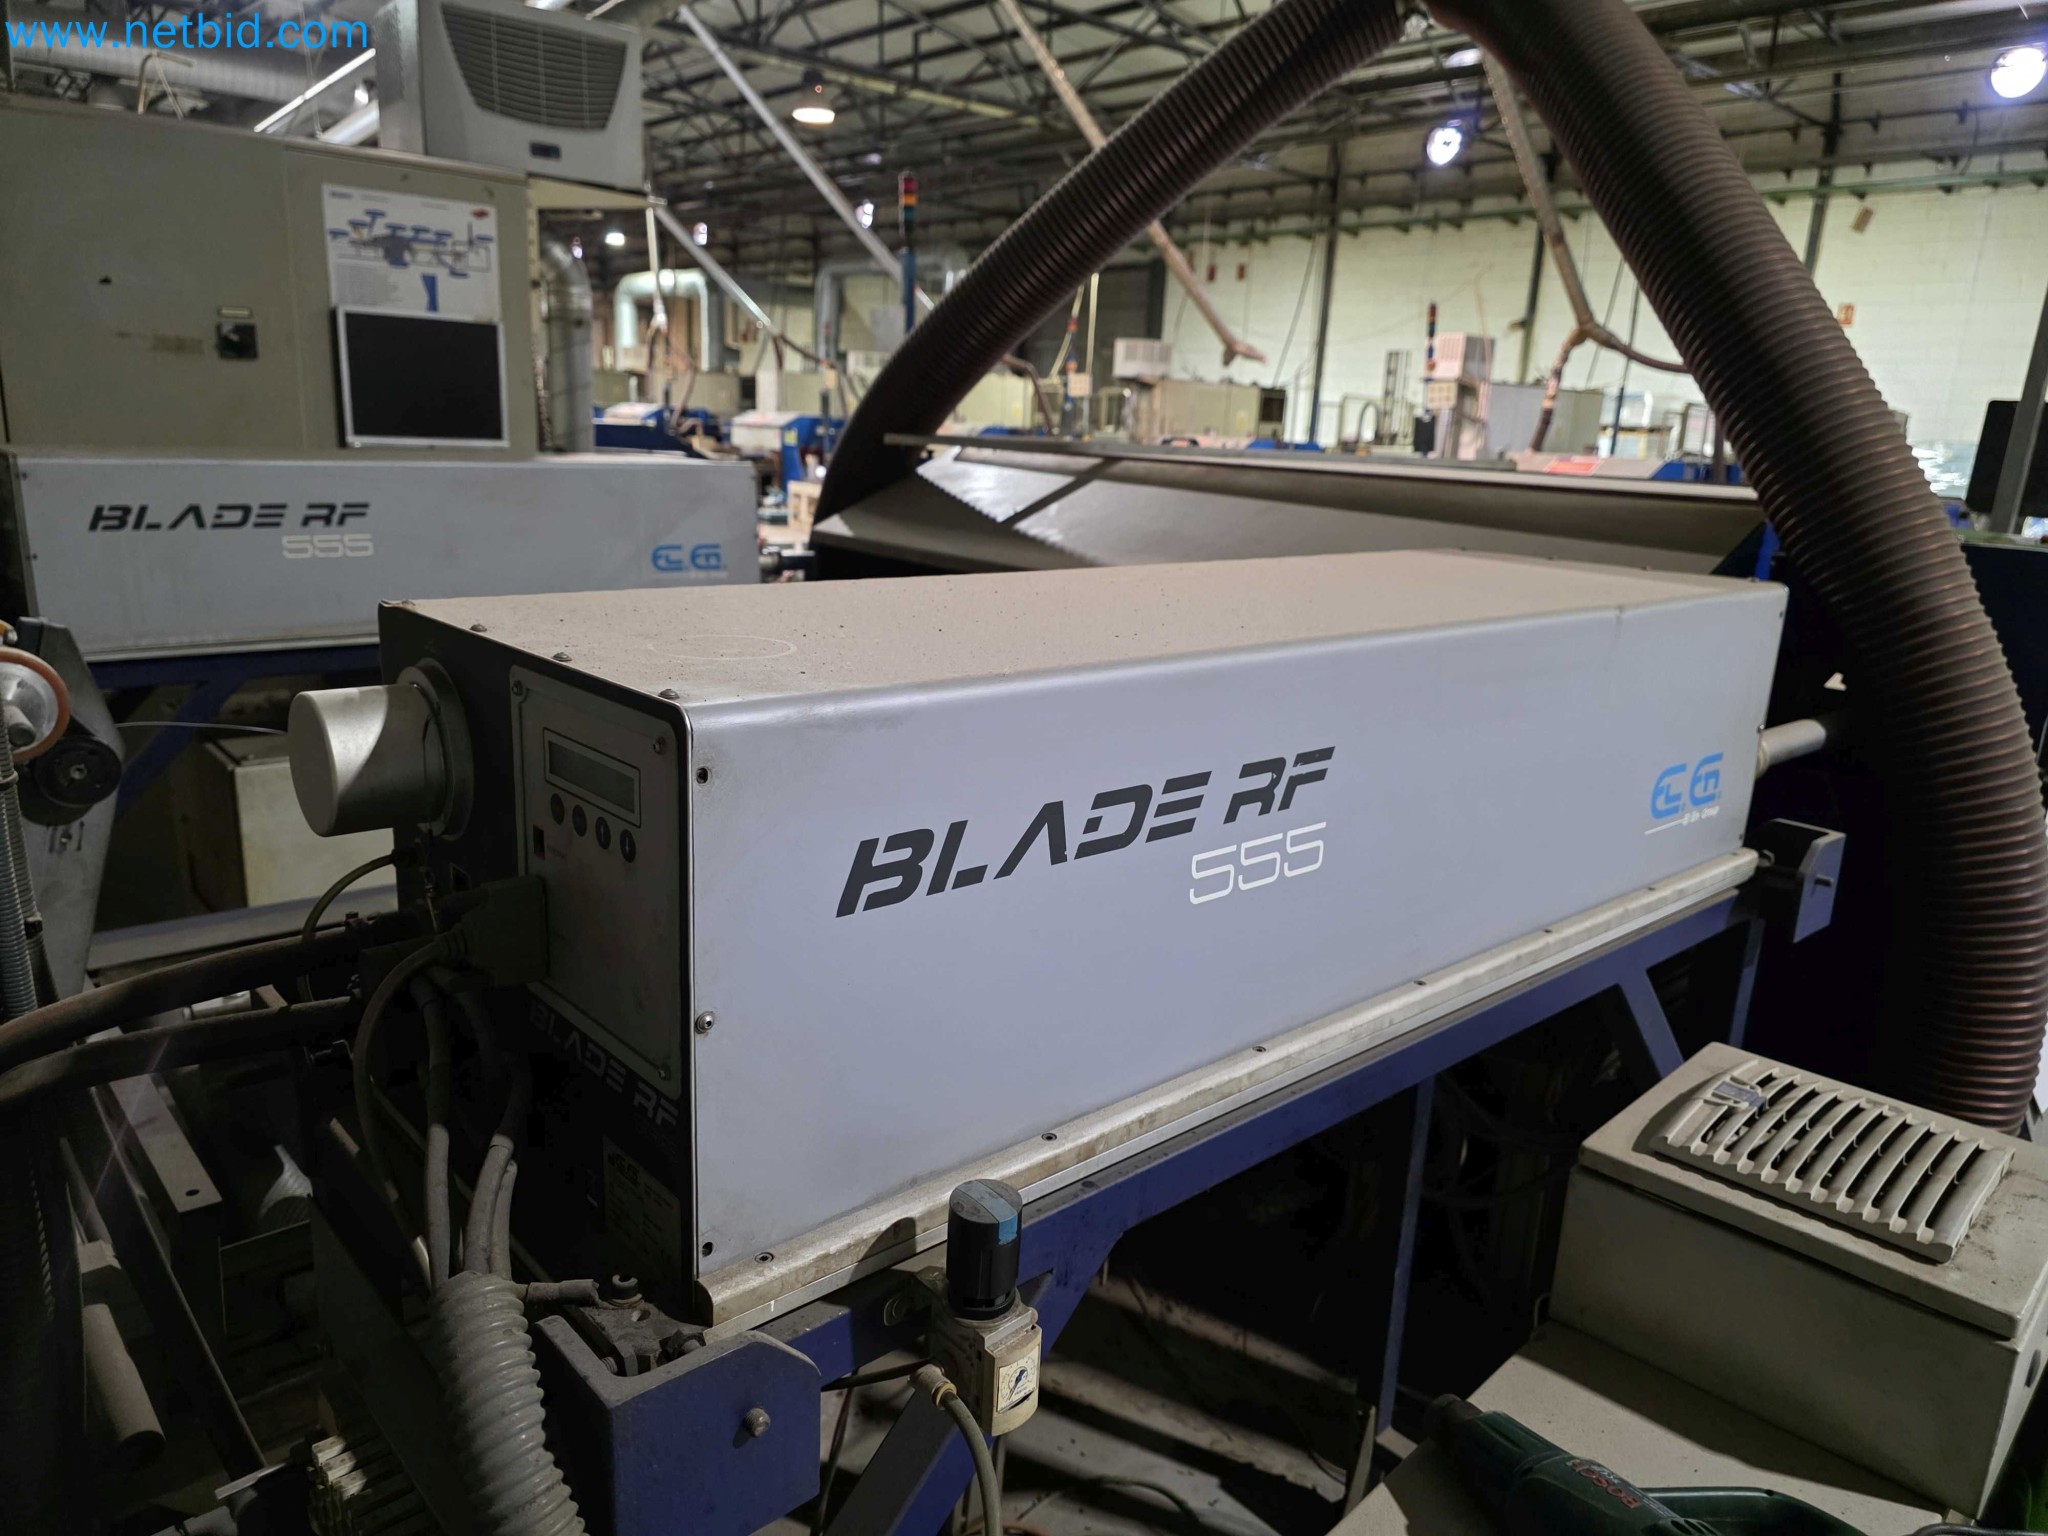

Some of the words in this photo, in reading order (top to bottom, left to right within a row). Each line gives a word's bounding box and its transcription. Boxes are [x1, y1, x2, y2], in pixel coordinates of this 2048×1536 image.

[88, 503, 288, 531] BLADE
[301, 503, 370, 528] RF
[281, 533, 374, 559] 555
[836, 771, 1212, 918] BLADE
[1223, 746, 1336, 824] RF
[1189, 821, 1327, 904] 555
[529, 1000, 627, 1094] BLADE
[632, 1081, 680, 1127] RF
[1568, 1459, 1642, 1509] BOSCH
